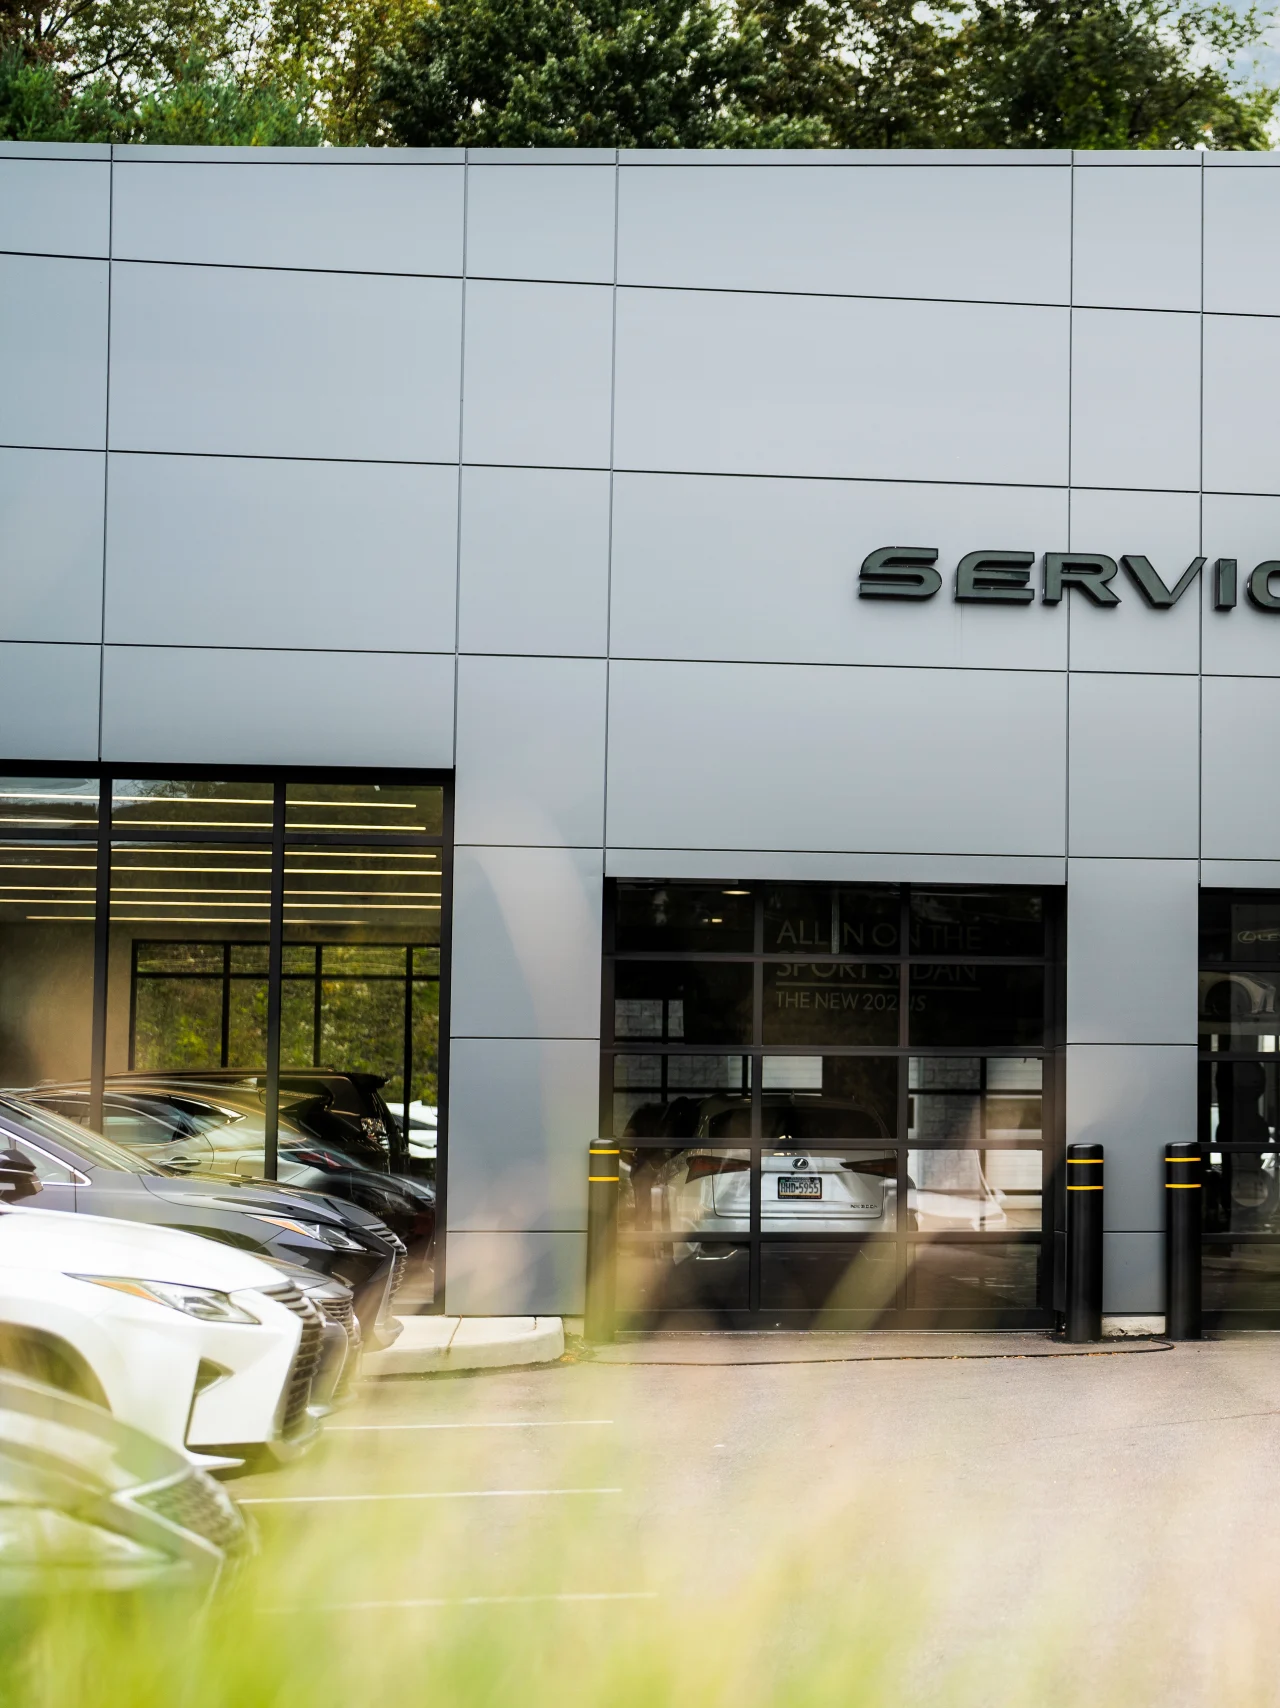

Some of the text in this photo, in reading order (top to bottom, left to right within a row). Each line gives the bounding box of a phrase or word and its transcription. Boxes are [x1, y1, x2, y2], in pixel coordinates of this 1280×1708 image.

[776, 918, 829, 946] ALL
[926, 924, 983, 951] THE
[776, 990, 811, 1009] THE
[815, 991, 859, 1010] NEW
[862, 992, 899, 1011] 202
